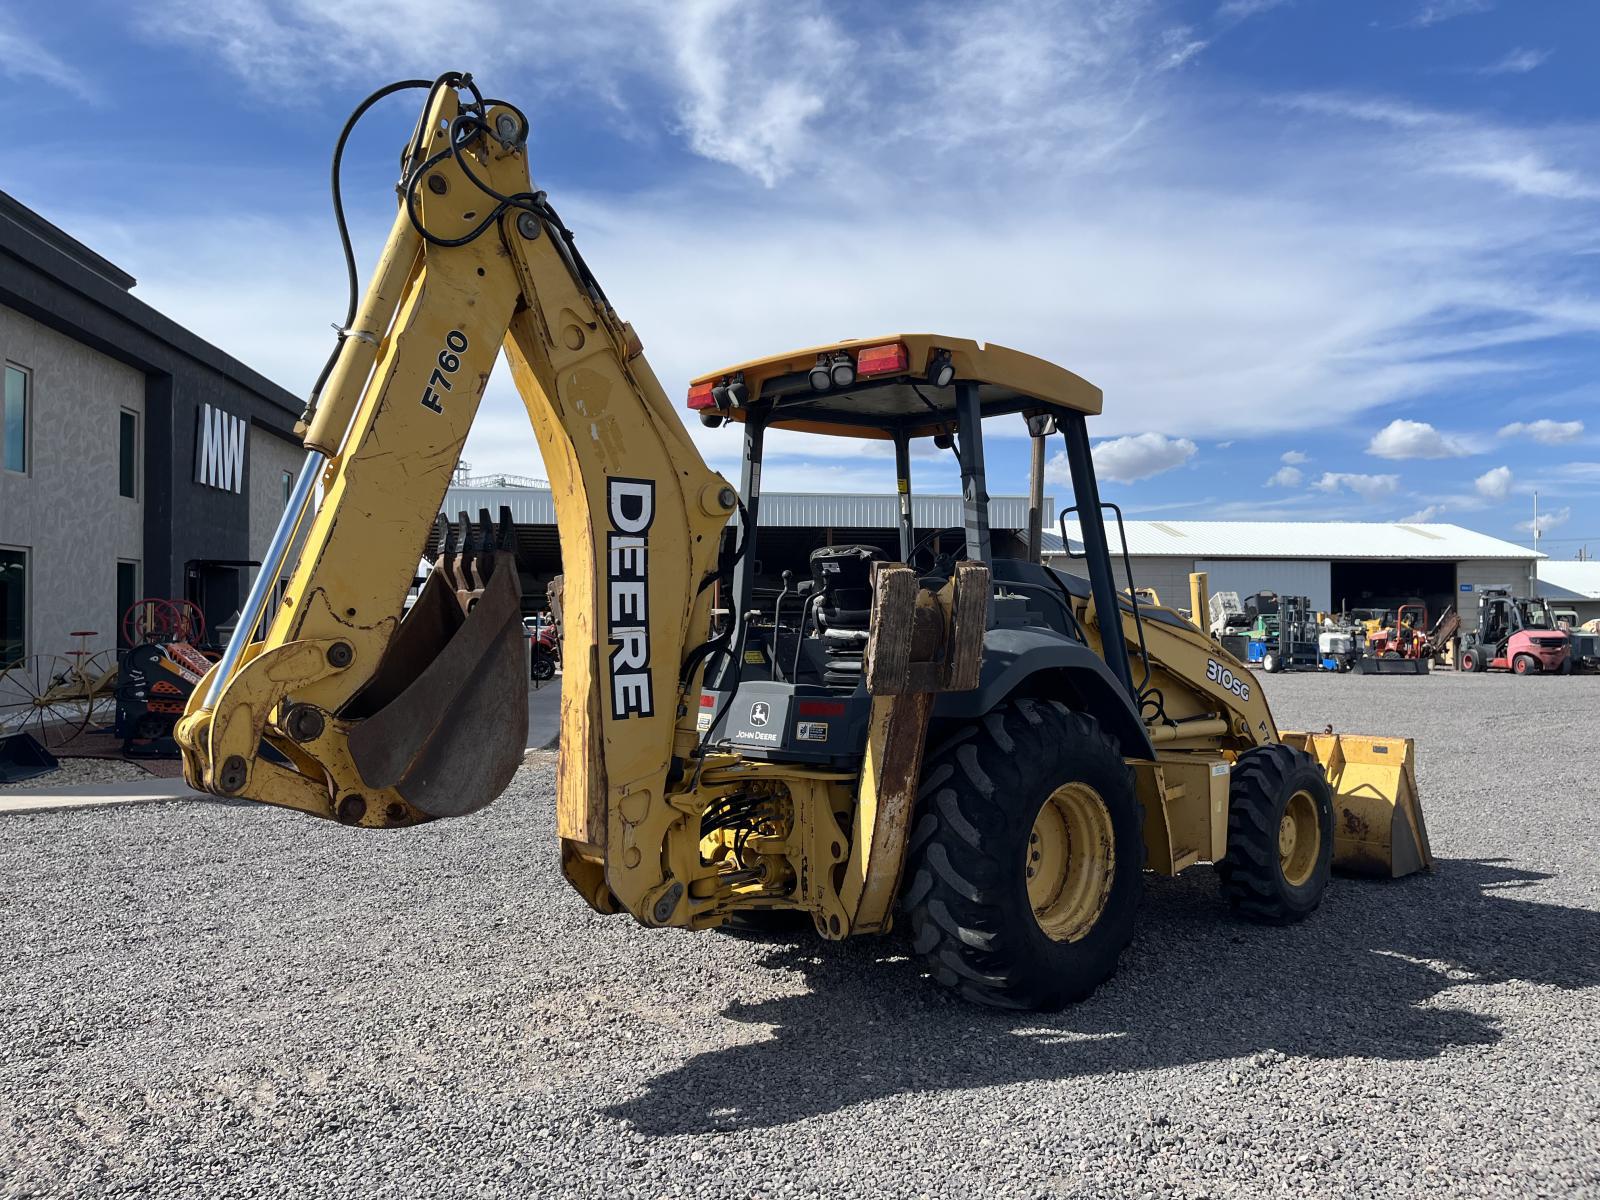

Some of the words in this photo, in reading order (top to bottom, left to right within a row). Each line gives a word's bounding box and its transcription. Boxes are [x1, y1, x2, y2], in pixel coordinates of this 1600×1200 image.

[420, 330, 468, 414] F760
[199, 402, 246, 494] MW
[608, 478, 655, 719] DEERE
[1206, 658, 1250, 701] 310SG
[735, 730, 754, 739] JOHN
[755, 731, 777, 741] DEERE
